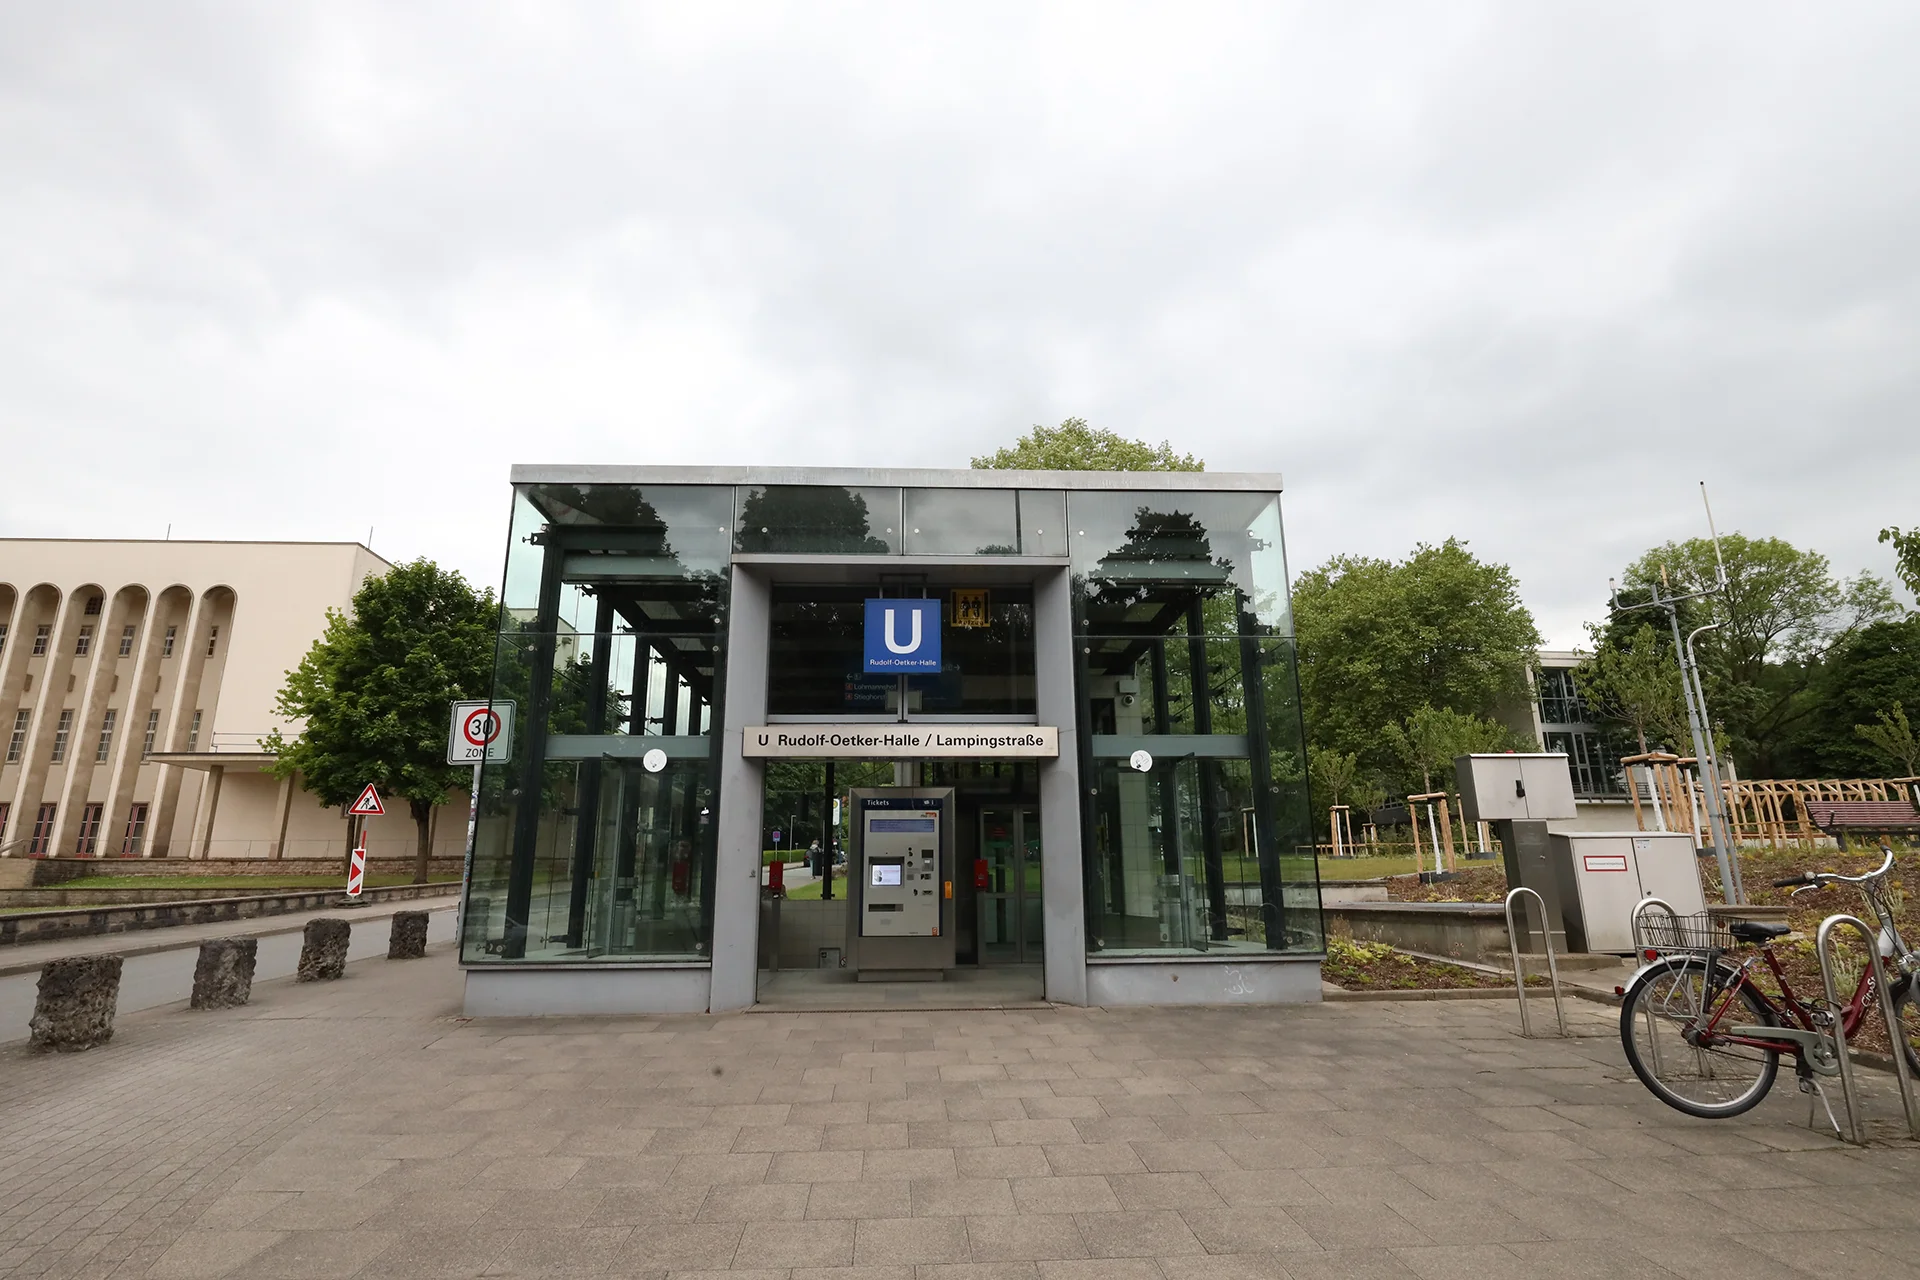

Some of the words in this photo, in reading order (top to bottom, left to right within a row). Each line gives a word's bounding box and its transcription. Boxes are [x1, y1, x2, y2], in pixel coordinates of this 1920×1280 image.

[884, 609, 922, 655] U
[471, 719, 493, 735] 30
[758, 734, 769, 746] U
[778, 734, 920, 746] Rudolf-Oetker-Halle
[925, 734, 932, 746] /
[936, 734, 1044, 749] Lampingstraße
